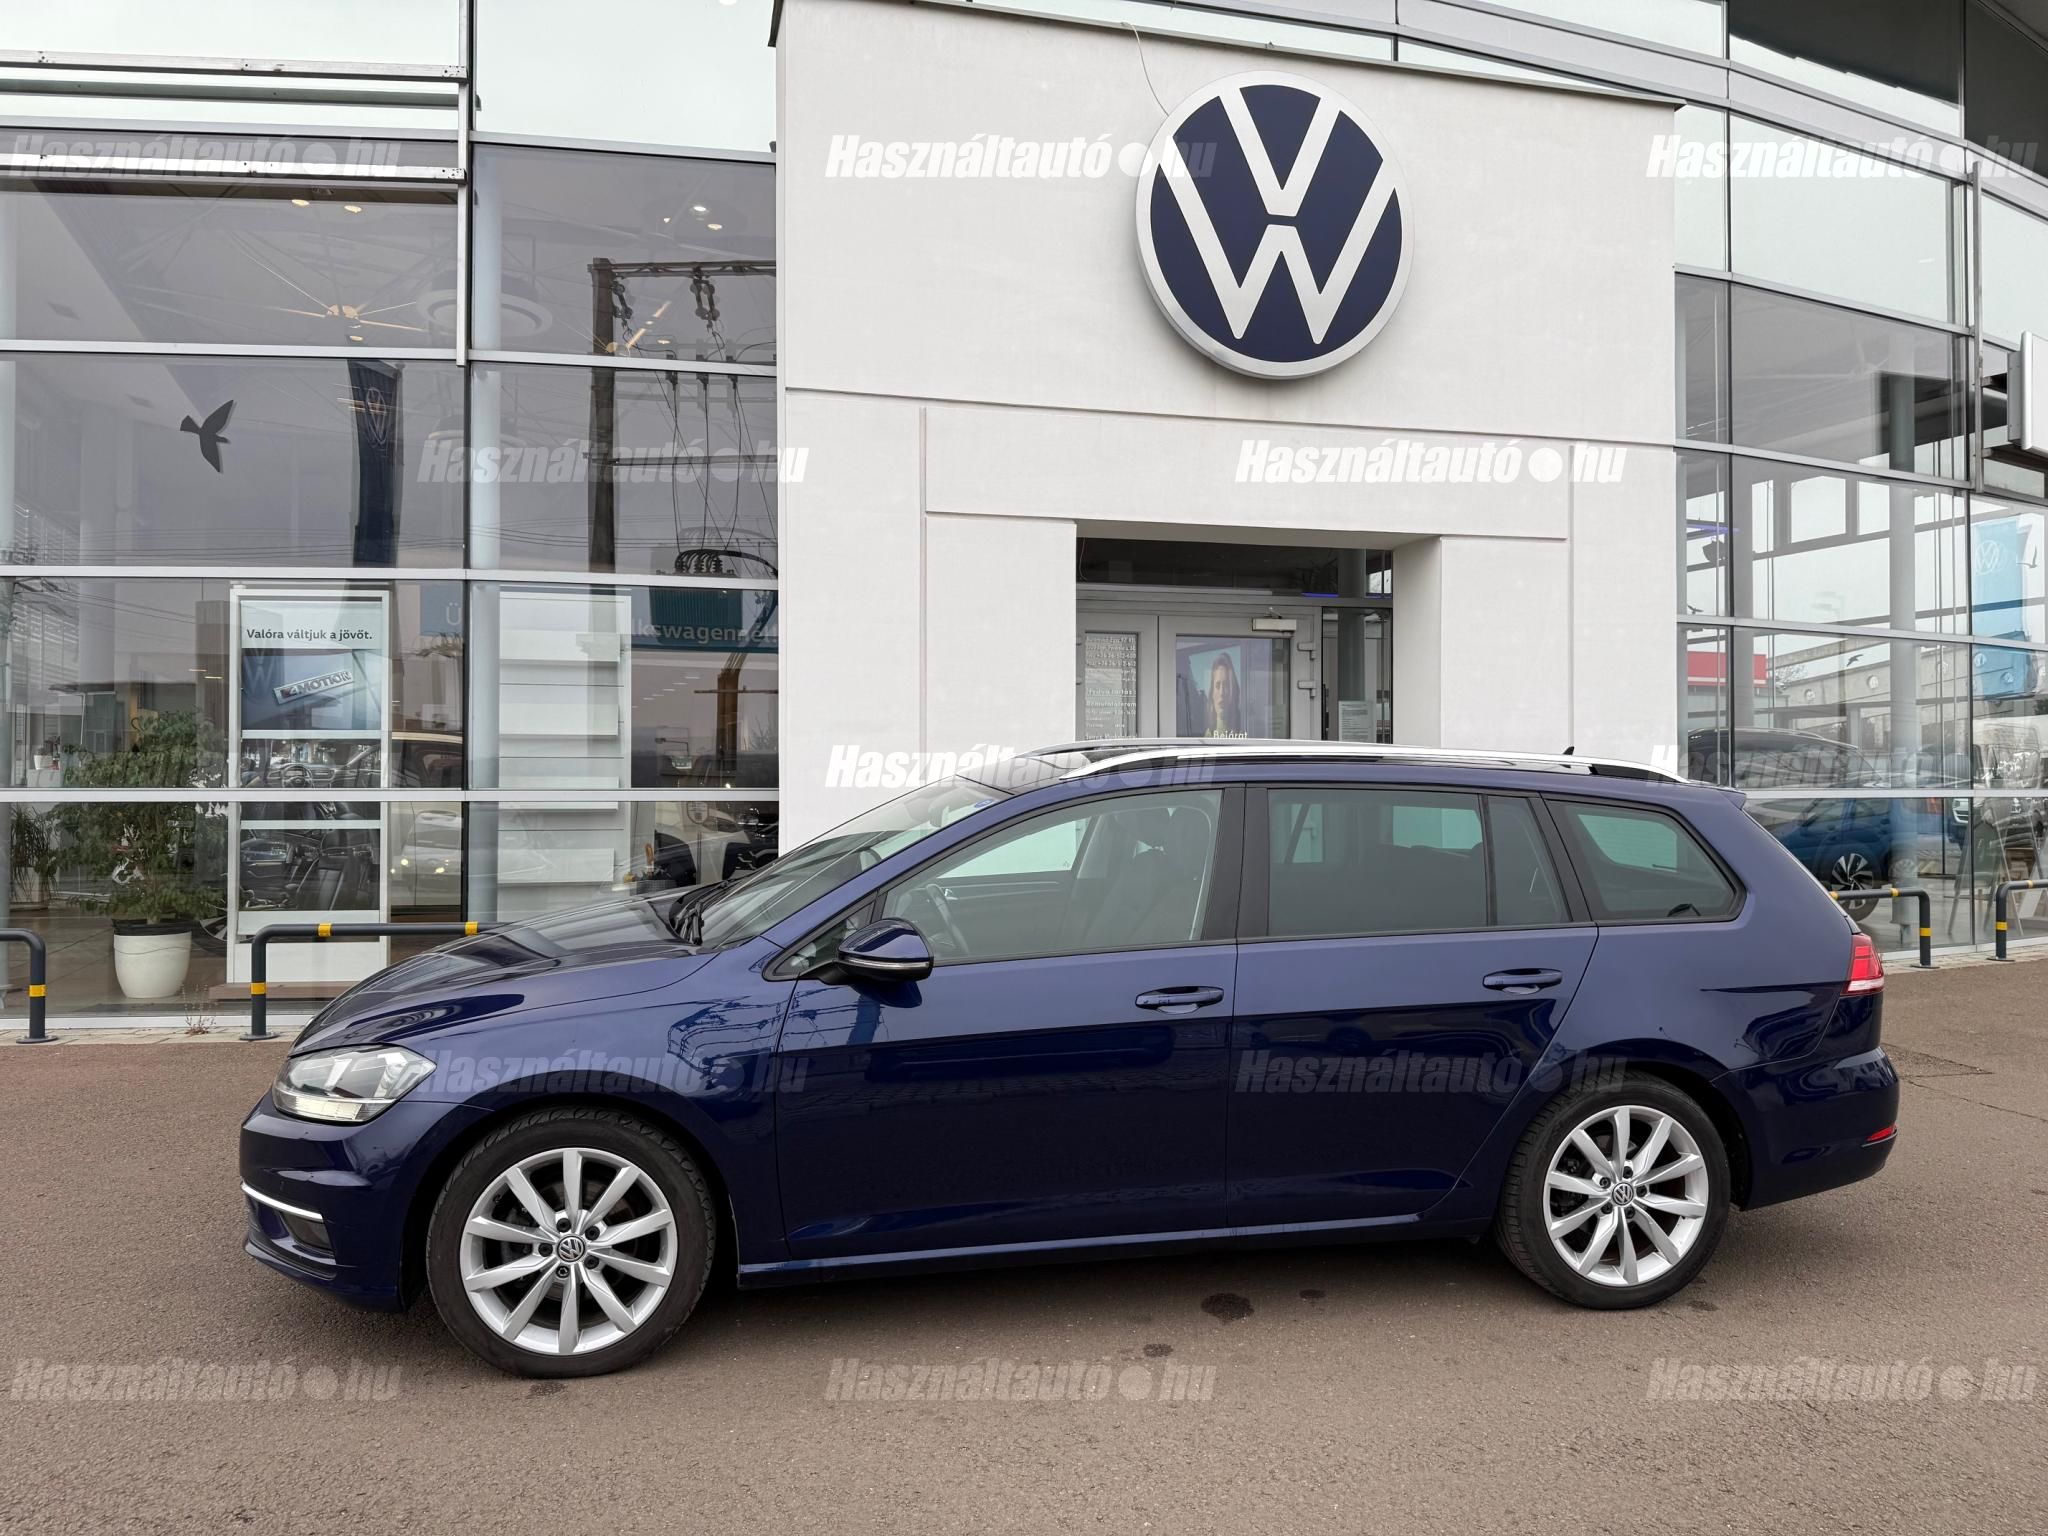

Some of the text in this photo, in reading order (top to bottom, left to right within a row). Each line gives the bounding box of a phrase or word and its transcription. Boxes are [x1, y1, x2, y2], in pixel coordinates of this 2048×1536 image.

[246, 629, 373, 641] Valóra váltjuk a jövőt.
